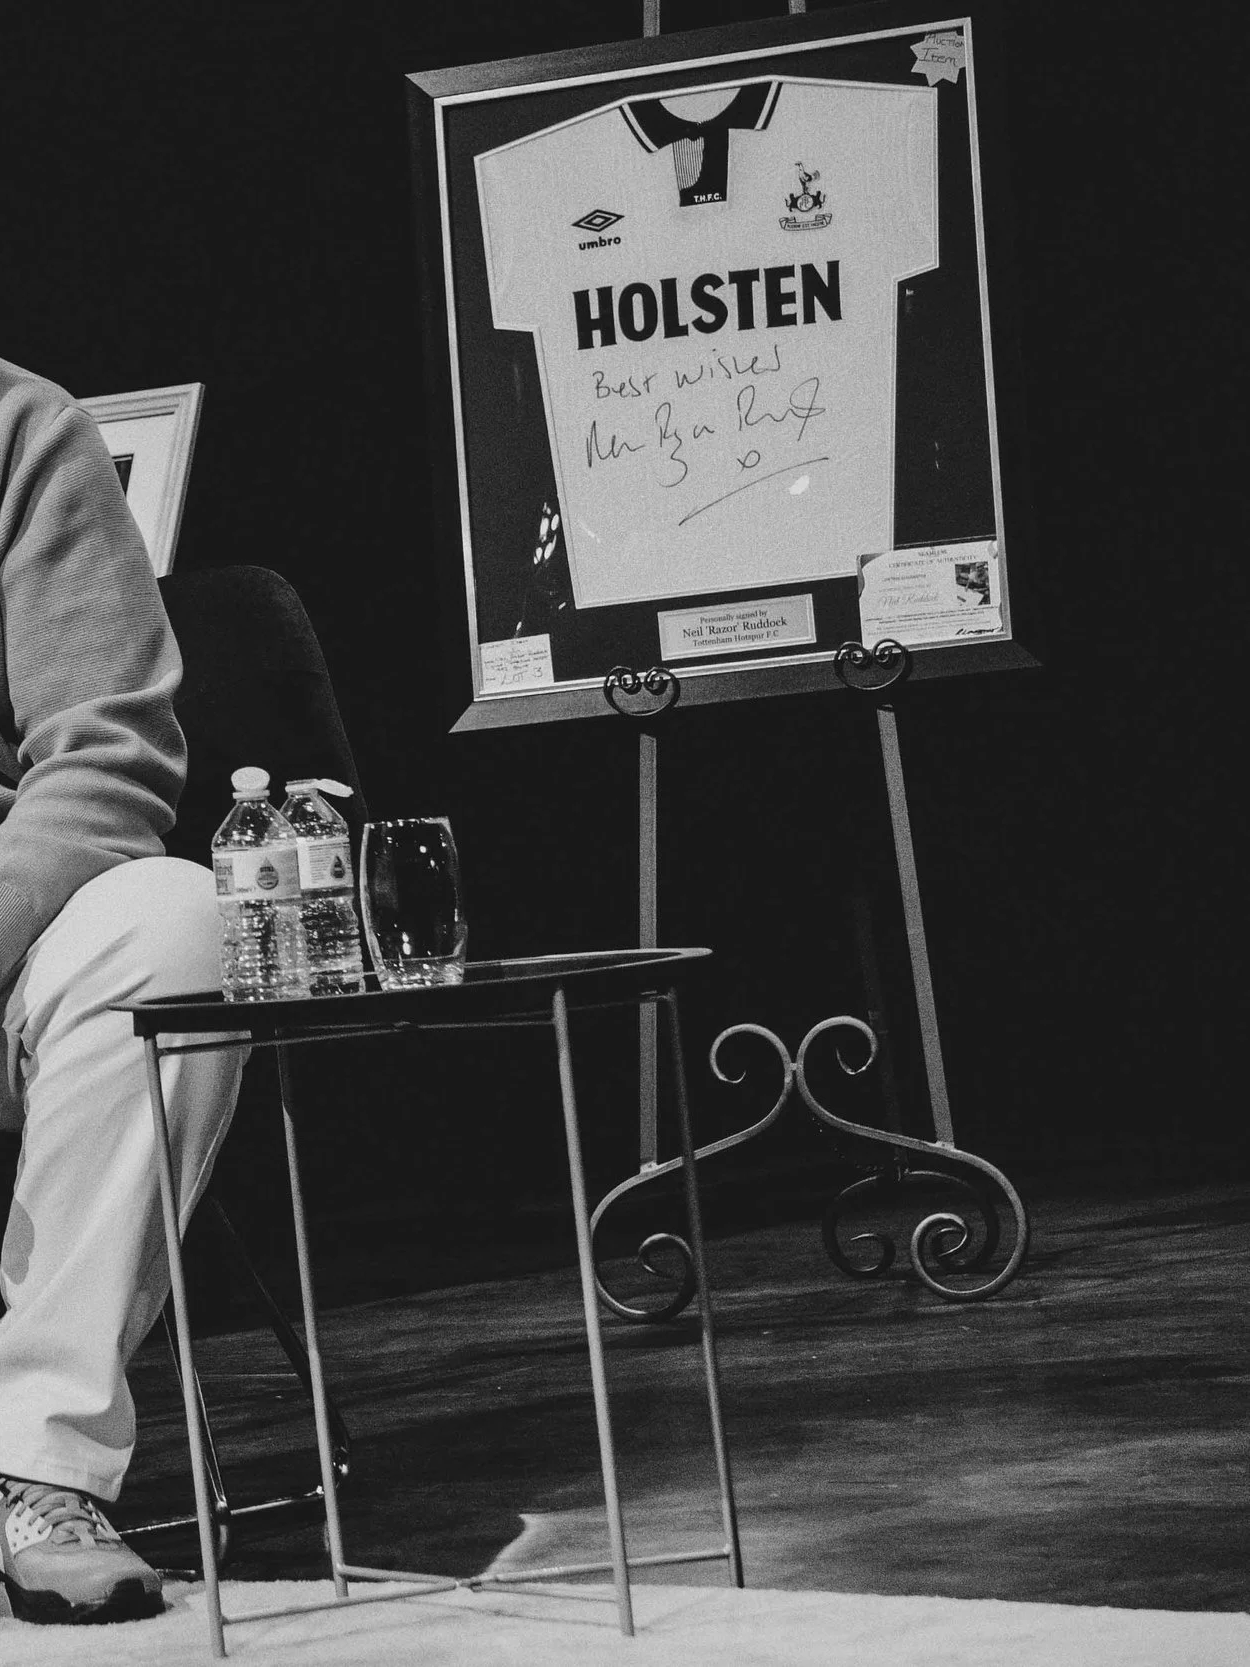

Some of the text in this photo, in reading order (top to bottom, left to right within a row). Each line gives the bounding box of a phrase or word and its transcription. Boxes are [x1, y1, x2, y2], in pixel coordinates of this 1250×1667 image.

[693, 192, 722, 203] T.H.F.C.
[579, 236, 621, 250] umbro
[572, 260, 842, 350] HOLSTEN
[593, 370, 658, 398] Best
[700, 610, 767, 624] Personally signed by
[683, 617, 787, 638] Neil 'Razor' Ruddock
[693, 636, 733, 647] Tottenham
[735, 632, 764, 642] Hotspur
